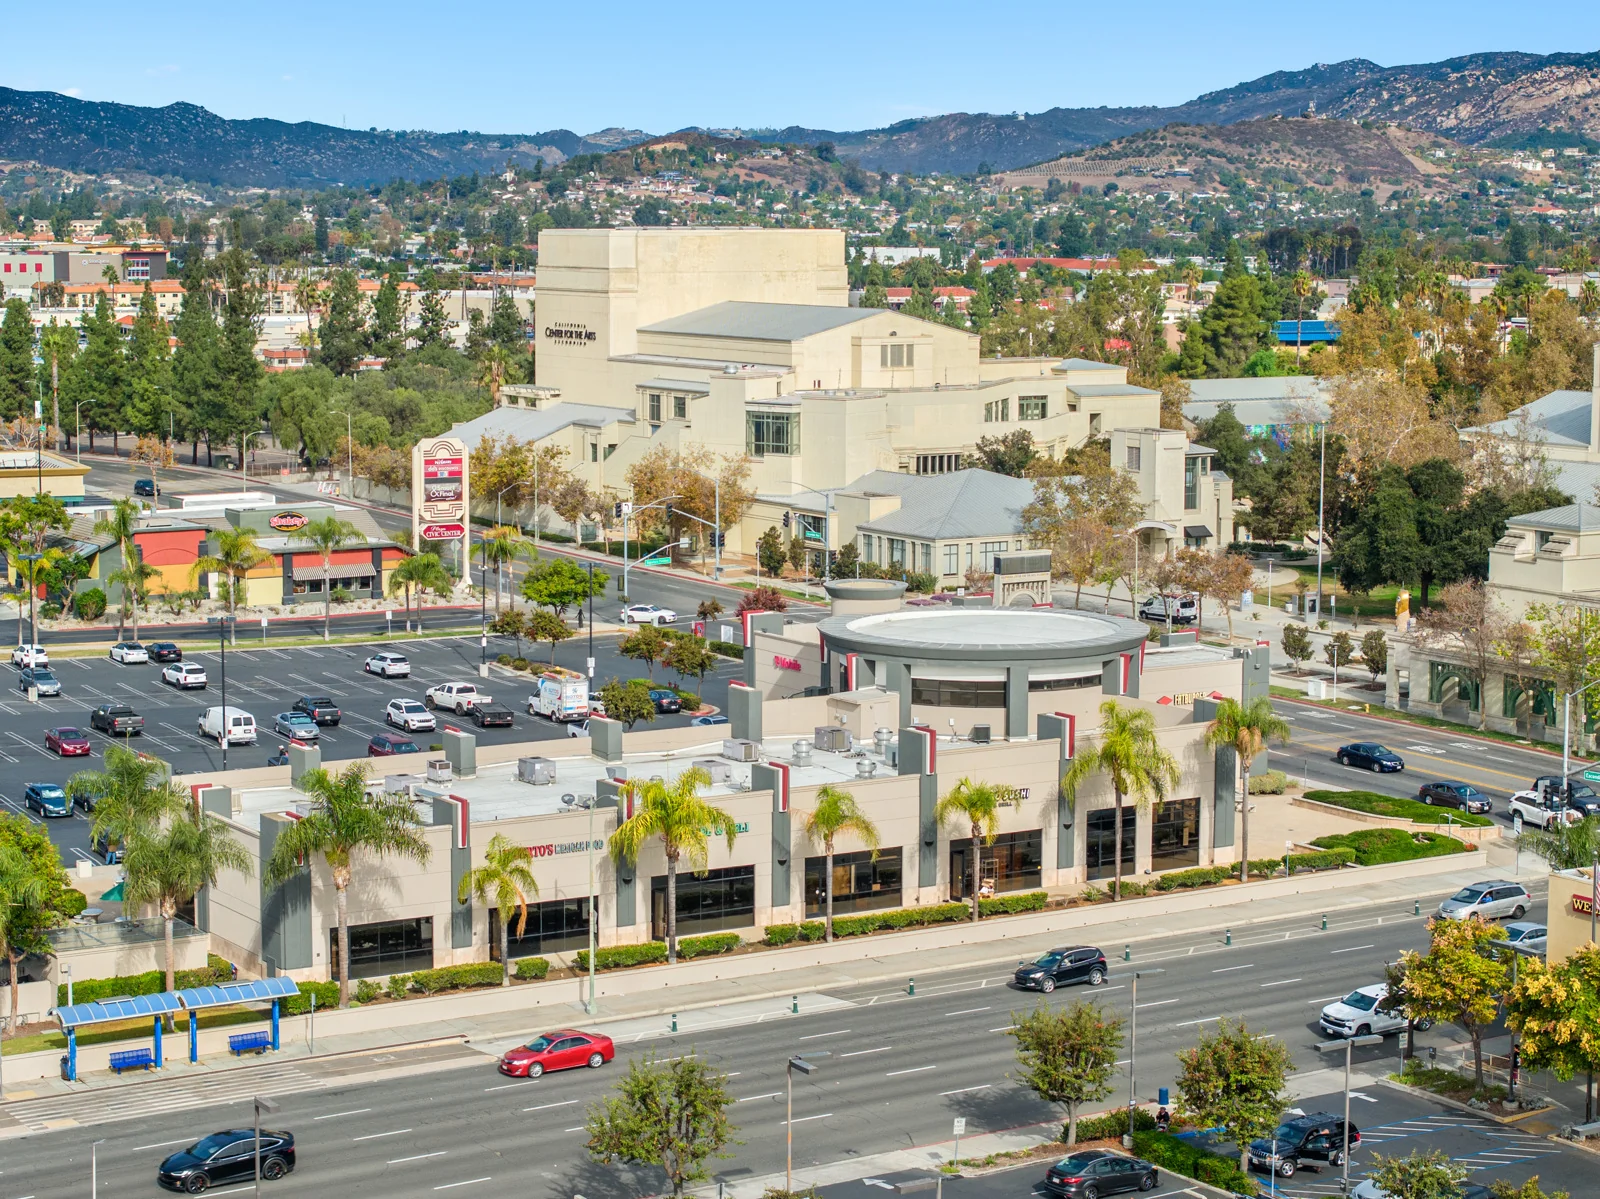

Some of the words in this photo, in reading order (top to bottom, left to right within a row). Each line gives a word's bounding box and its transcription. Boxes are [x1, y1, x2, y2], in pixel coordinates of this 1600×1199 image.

[545, 326, 564, 338] CENTER
[564, 329, 574, 339] FOR
[574, 330, 584, 340] THE
[584, 329, 597, 341] ARTS
